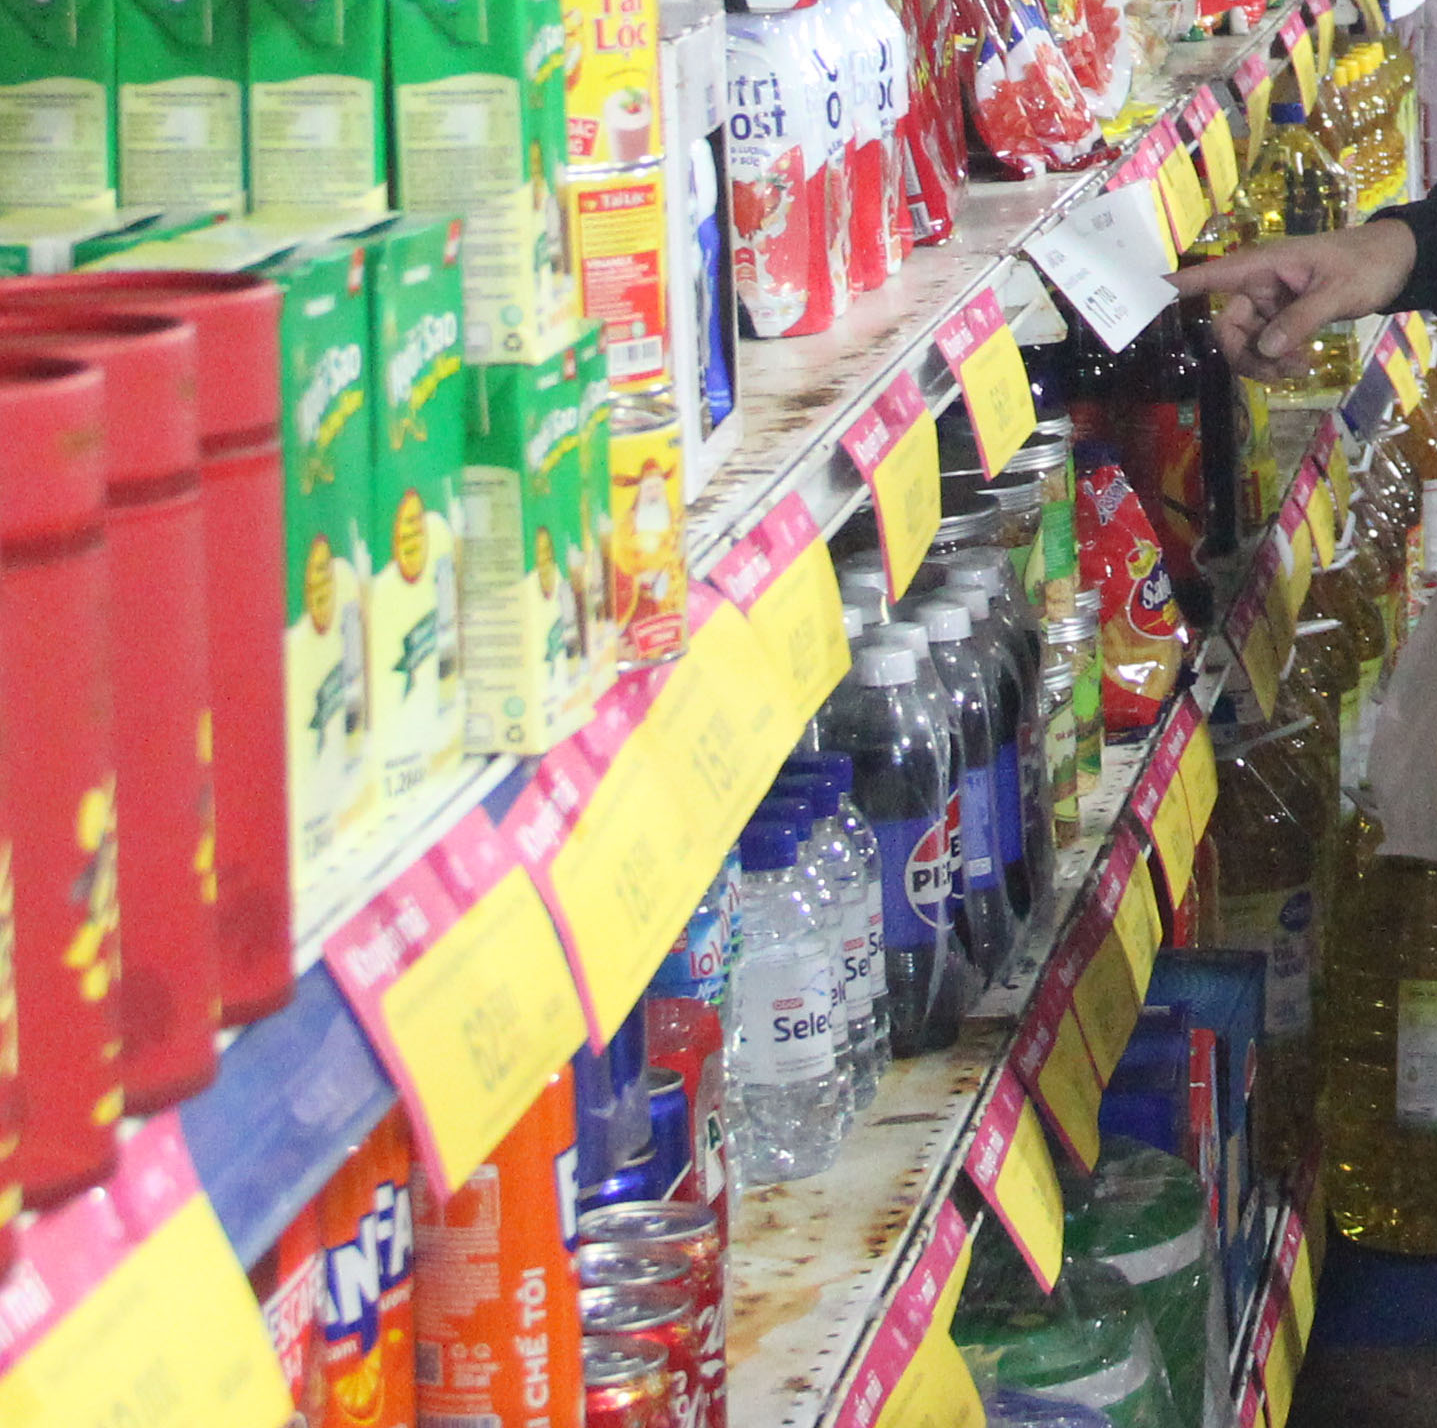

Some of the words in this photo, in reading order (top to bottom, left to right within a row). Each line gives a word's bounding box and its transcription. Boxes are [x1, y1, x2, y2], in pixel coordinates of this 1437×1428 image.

[729, 103, 786, 141] ost
[513, 1266, 547, 1329] TÔI
[512, 1333, 550, 1409] CHẾ
